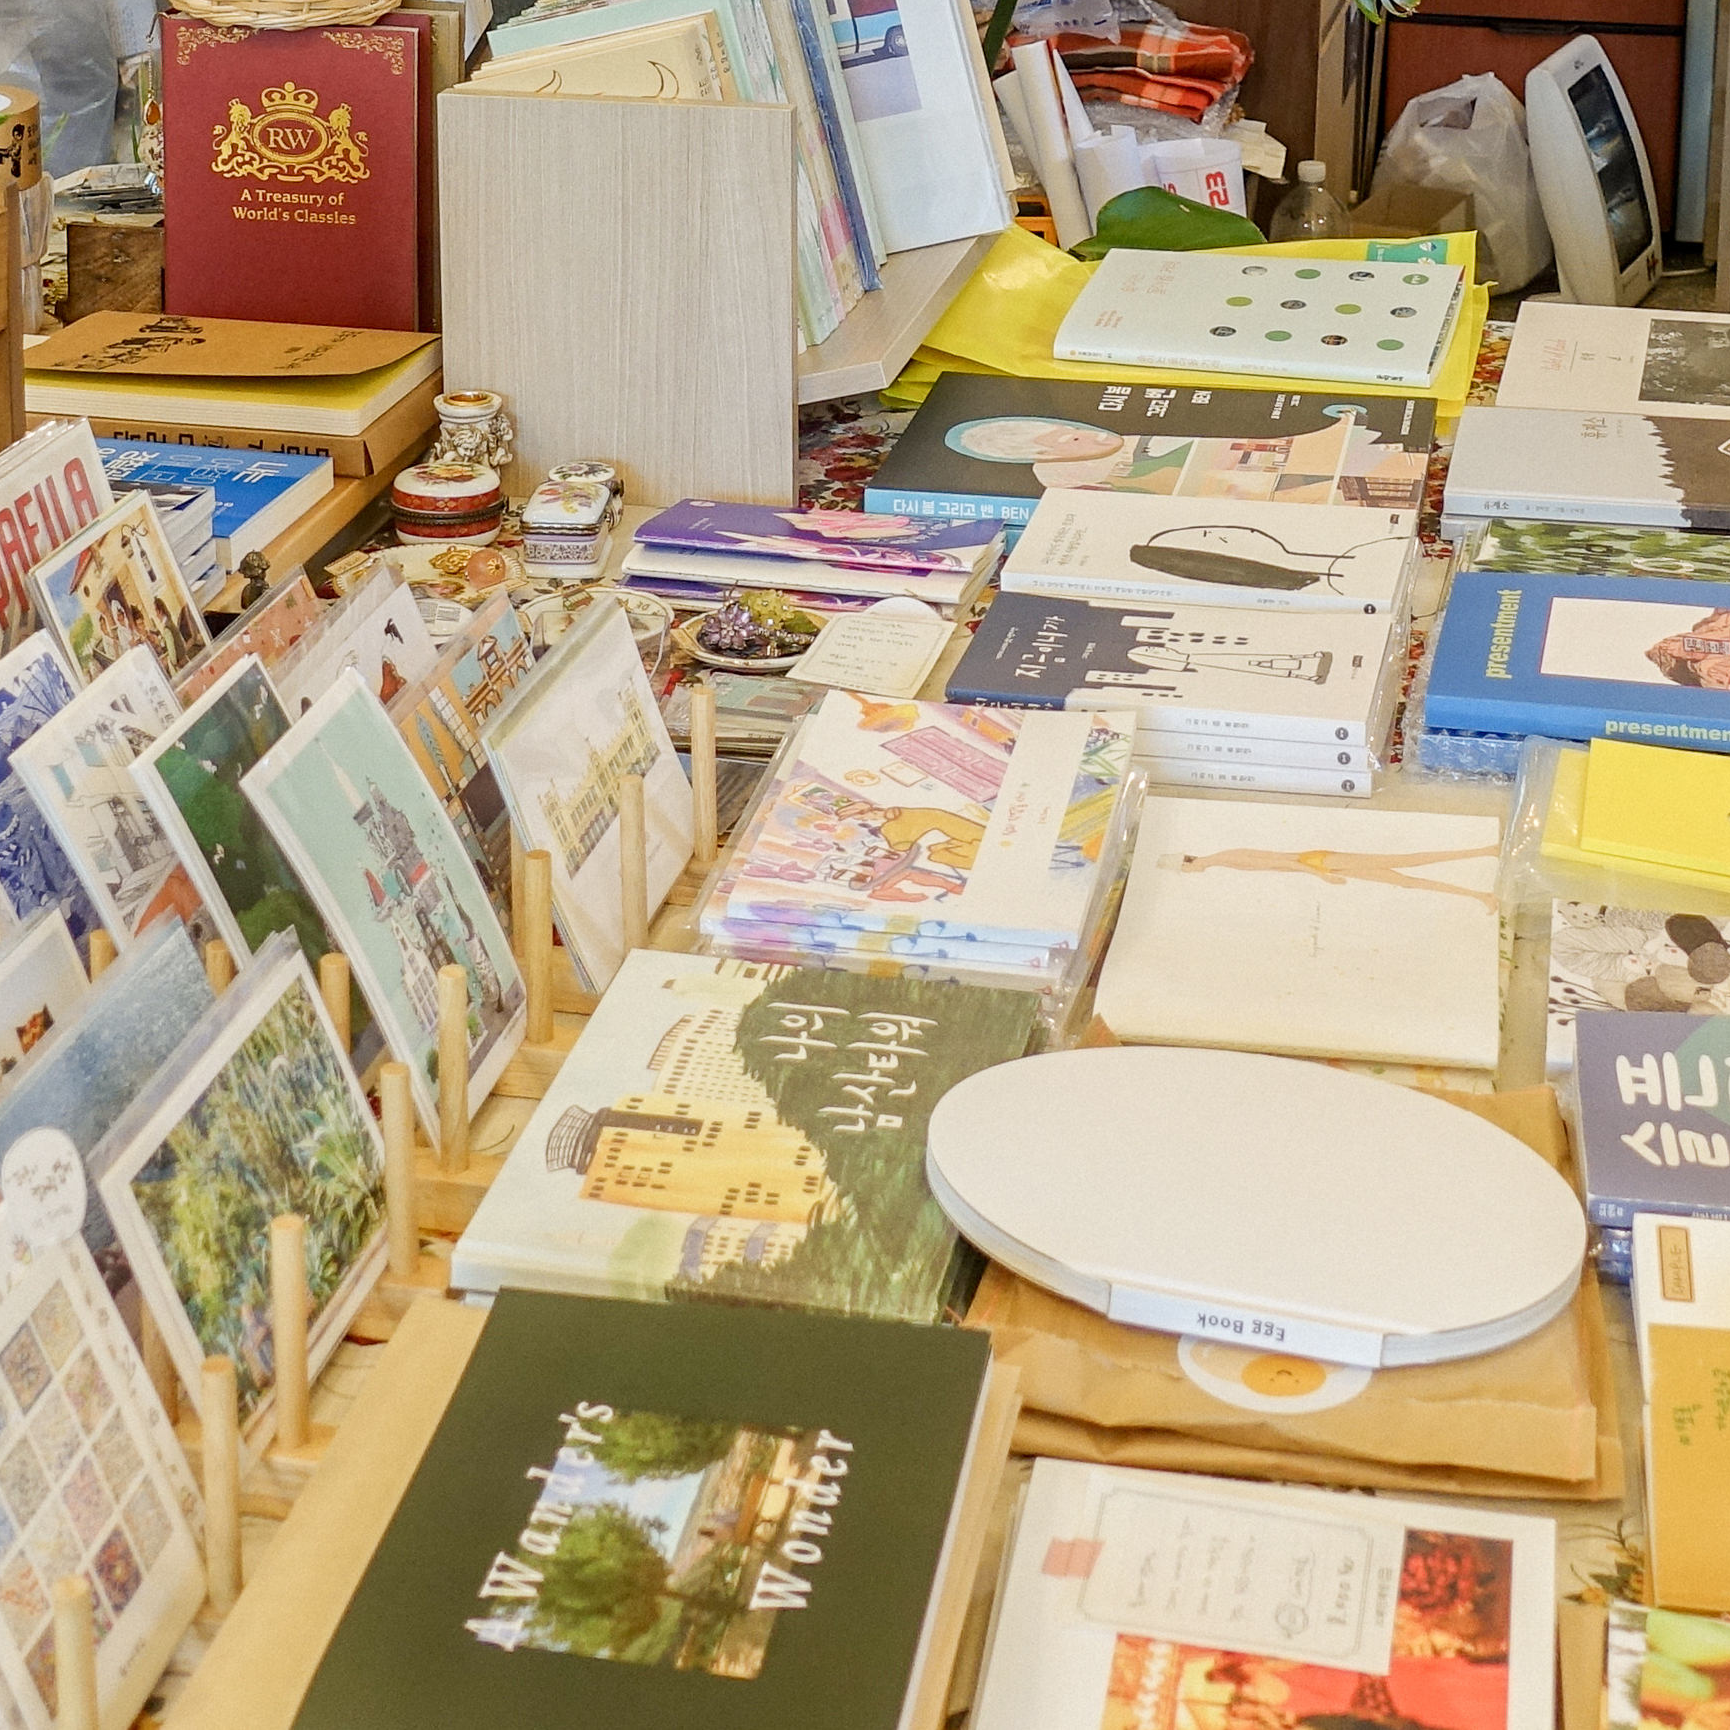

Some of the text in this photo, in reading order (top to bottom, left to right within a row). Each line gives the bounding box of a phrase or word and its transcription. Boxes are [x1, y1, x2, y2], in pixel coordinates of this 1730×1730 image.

[268, 127, 315, 151] RW
[232, 206, 357, 225] World's Classics
[240, 188, 344, 207] A Treasury of
[893, 498, 1030, 521] 다시 봄 그리고 벤 BEN
[1484, 589, 1523, 681] presentment
[757, 1001, 851, 1064] 나의
[816, 1010, 940, 1136] 남산타워
[1667, 1244, 1684, 1296] SAMPLE
[1196, 1310, 1287, 1343] Egg Book
[463, 1399, 616, 1654] A Wander's
[748, 1428, 856, 1613] Wonder
